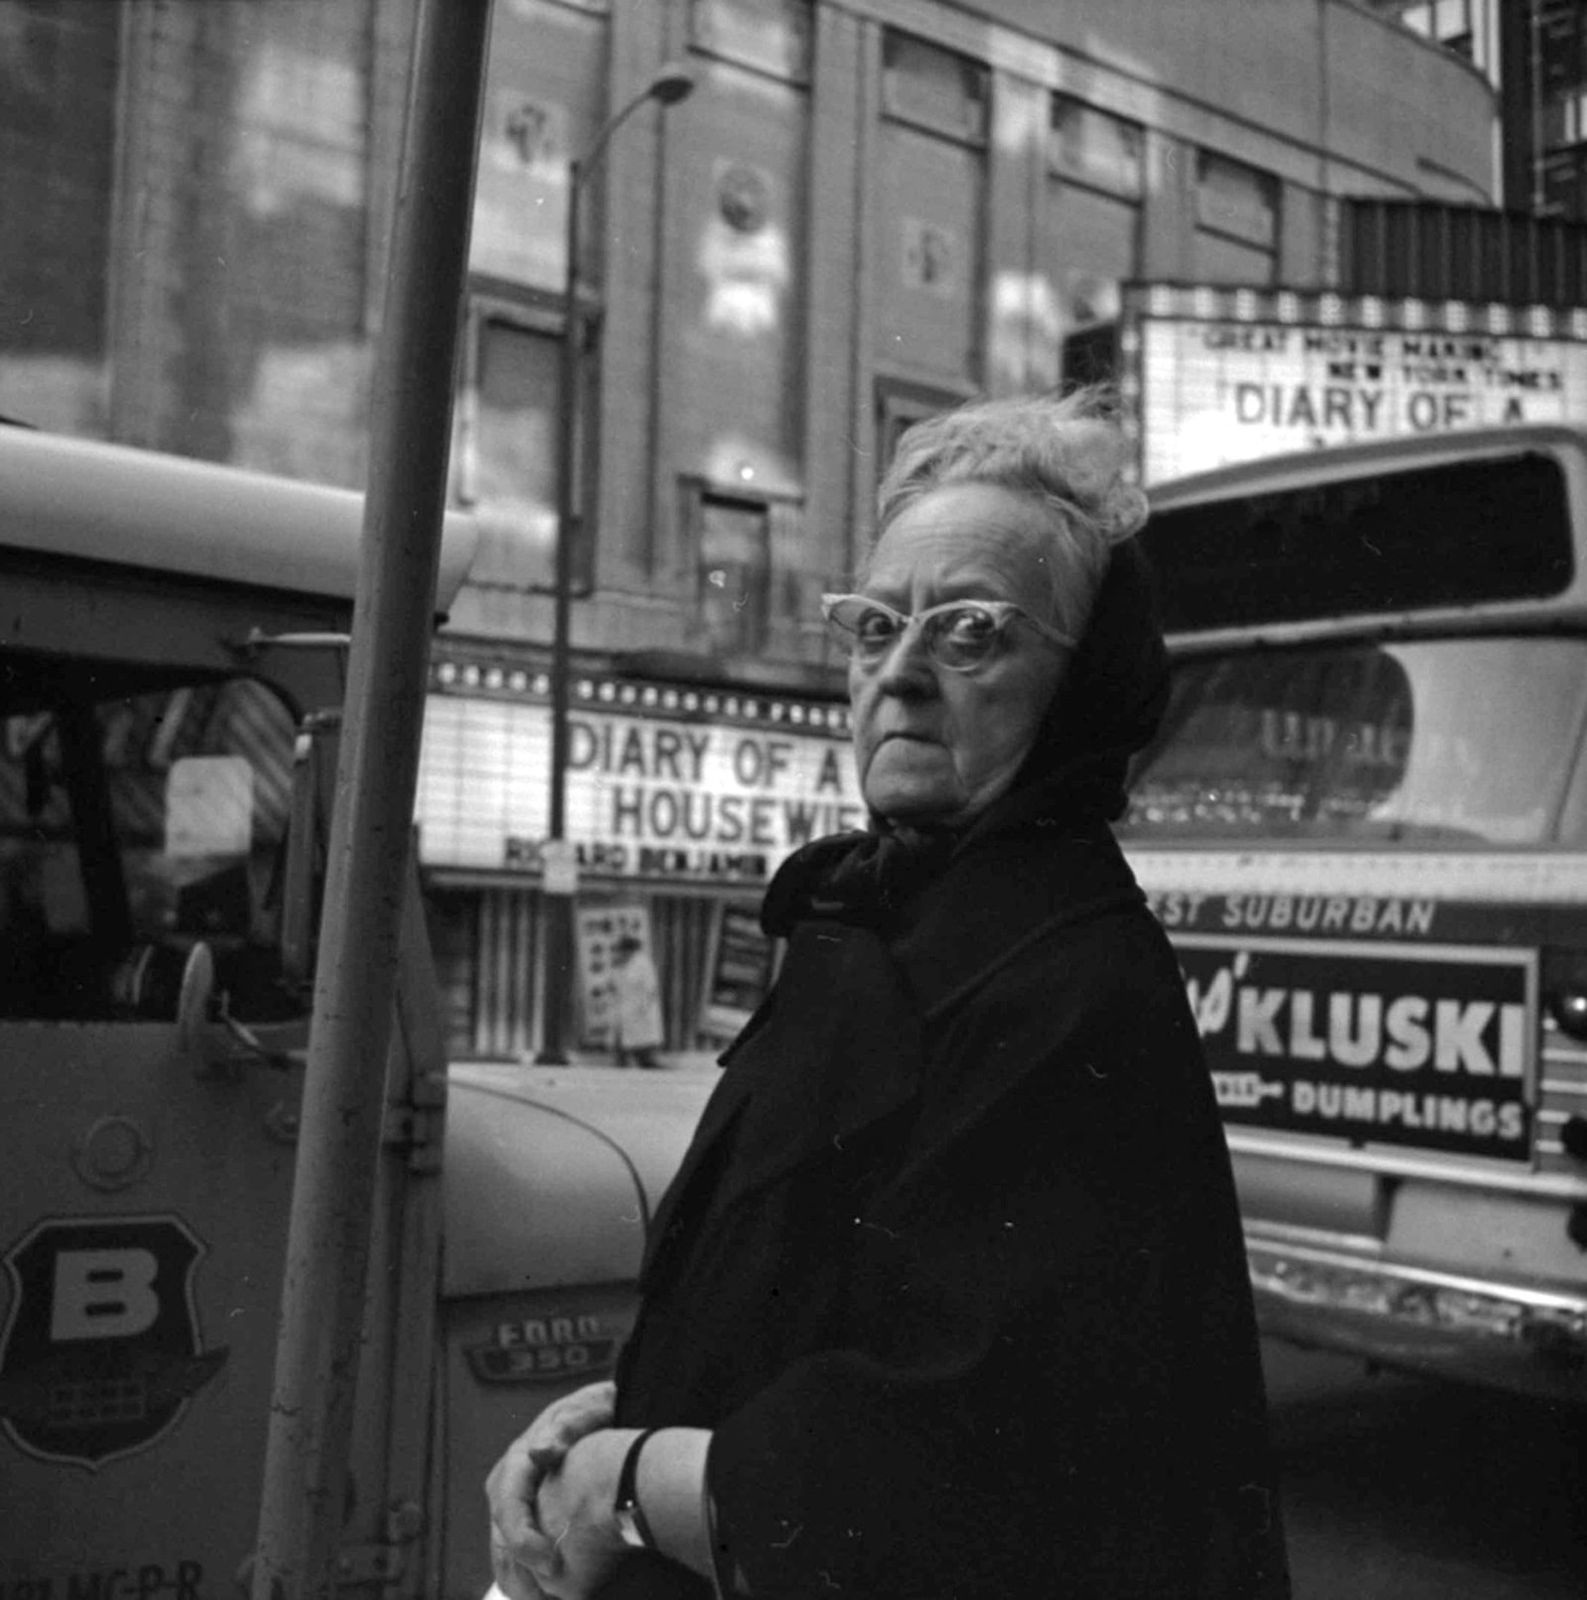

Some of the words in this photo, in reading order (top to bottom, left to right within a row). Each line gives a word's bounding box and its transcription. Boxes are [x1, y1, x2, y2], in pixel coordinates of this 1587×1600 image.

[1235, 382, 1385, 430] DIARY
[1407, 392, 1472, 430] OF
[1503, 398, 1523, 424] A
[566, 720, 710, 782] DIARY
[734, 738, 793, 790] OF
[816, 748, 842, 794] A
[612, 784, 863, 846] HOUSEWIF
[506, 838, 628, 872] RICARD
[1223, 895, 1437, 934] SUBURBAN
[1237, 986, 1525, 1079] KLUSKI
[1292, 1080, 1524, 1140] DUMPLINGS
[50, 1247, 160, 1341] B
